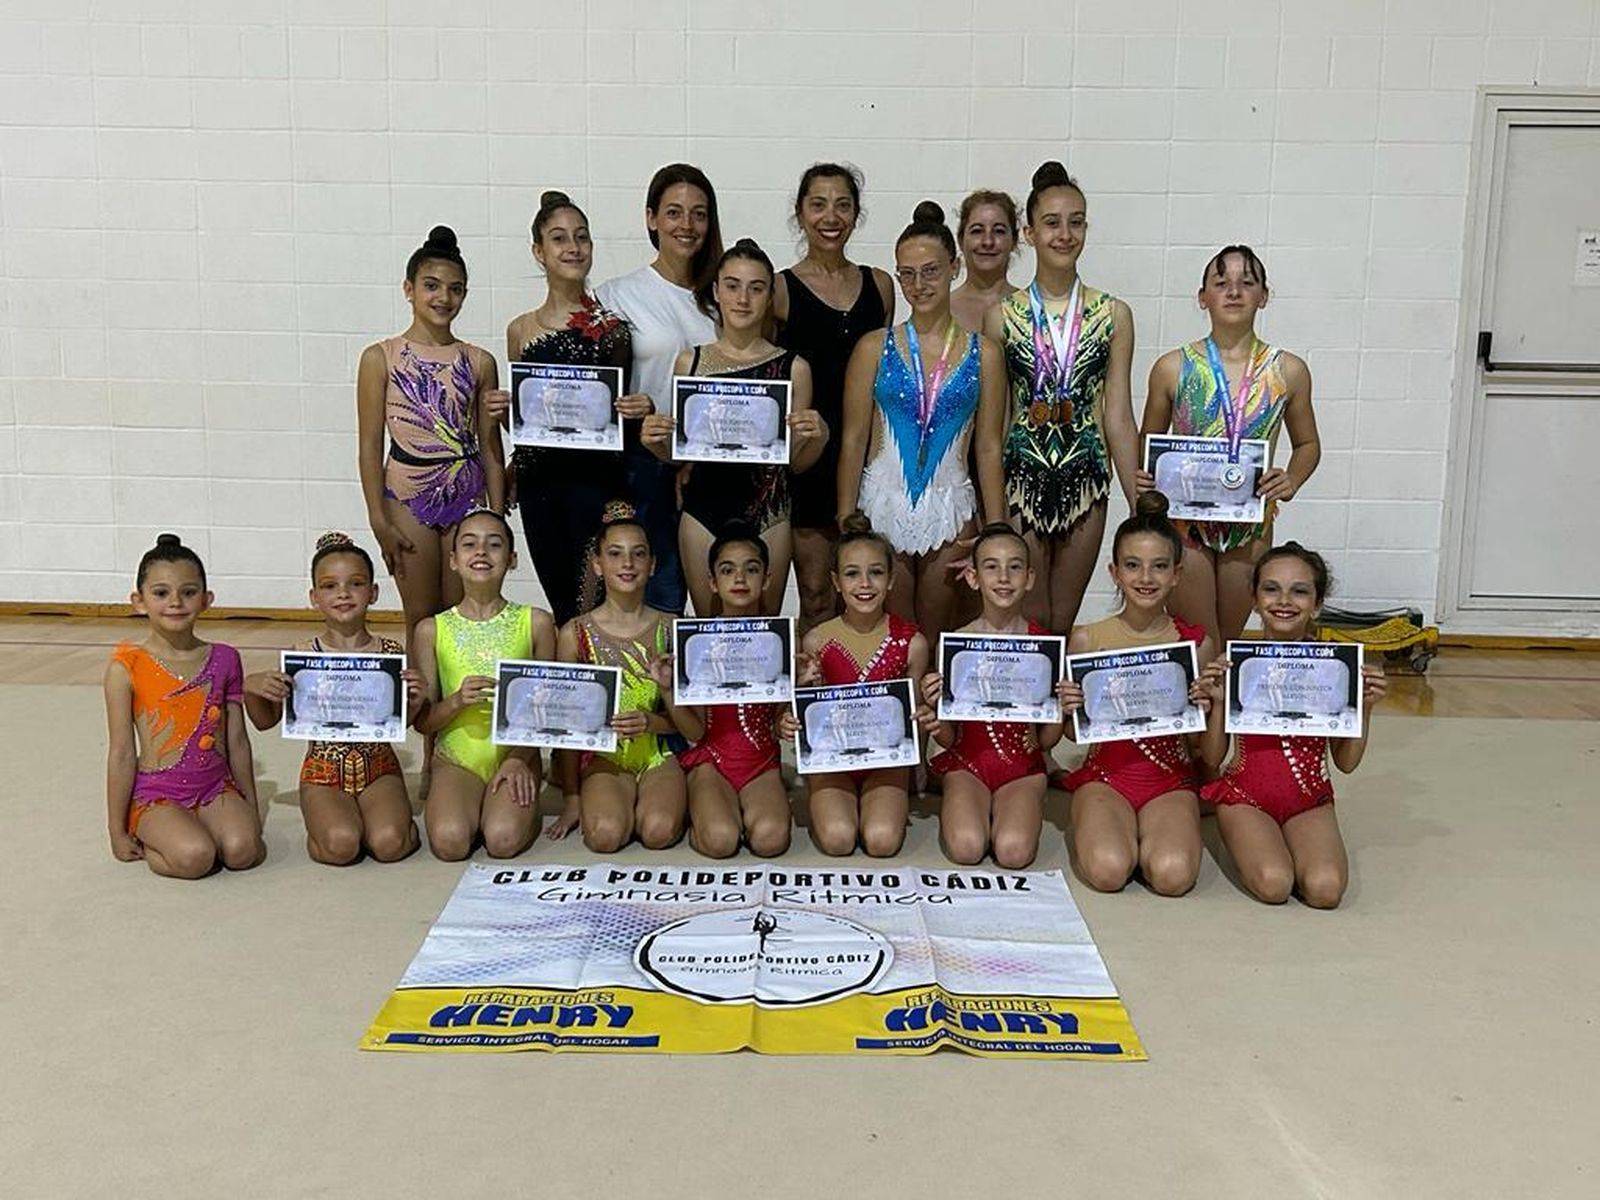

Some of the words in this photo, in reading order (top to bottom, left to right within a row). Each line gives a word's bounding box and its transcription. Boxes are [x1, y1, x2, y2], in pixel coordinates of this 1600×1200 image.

[492, 869, 587, 885] CLUB
[608, 869, 901, 887] POLIDEPORTIVO
[921, 871, 1032, 891] CÁDIZ
[537, 886, 748, 905] Gimnasia
[658, 955, 696, 964] CLUB
[703, 953, 819, 965] POLIDEPORTIVO
[826, 951, 871, 964] CÁDIZ
[464, 991, 614, 1006] REPARACIONES
[429, 1004, 634, 1029] HENRY
[884, 1001, 1080, 1035] HENRY
[417, 1035, 480, 1046] SERVICIO
[484, 1033, 550, 1046] INTEGRAL
[554, 1036, 578, 1047] DEL
[582, 1036, 629, 1046] HOGAR
[887, 1030, 945, 1047] SERVICIO
[1016, 1041, 1040, 1051] DEL
[1042, 1042, 1092, 1053] HOGAR
